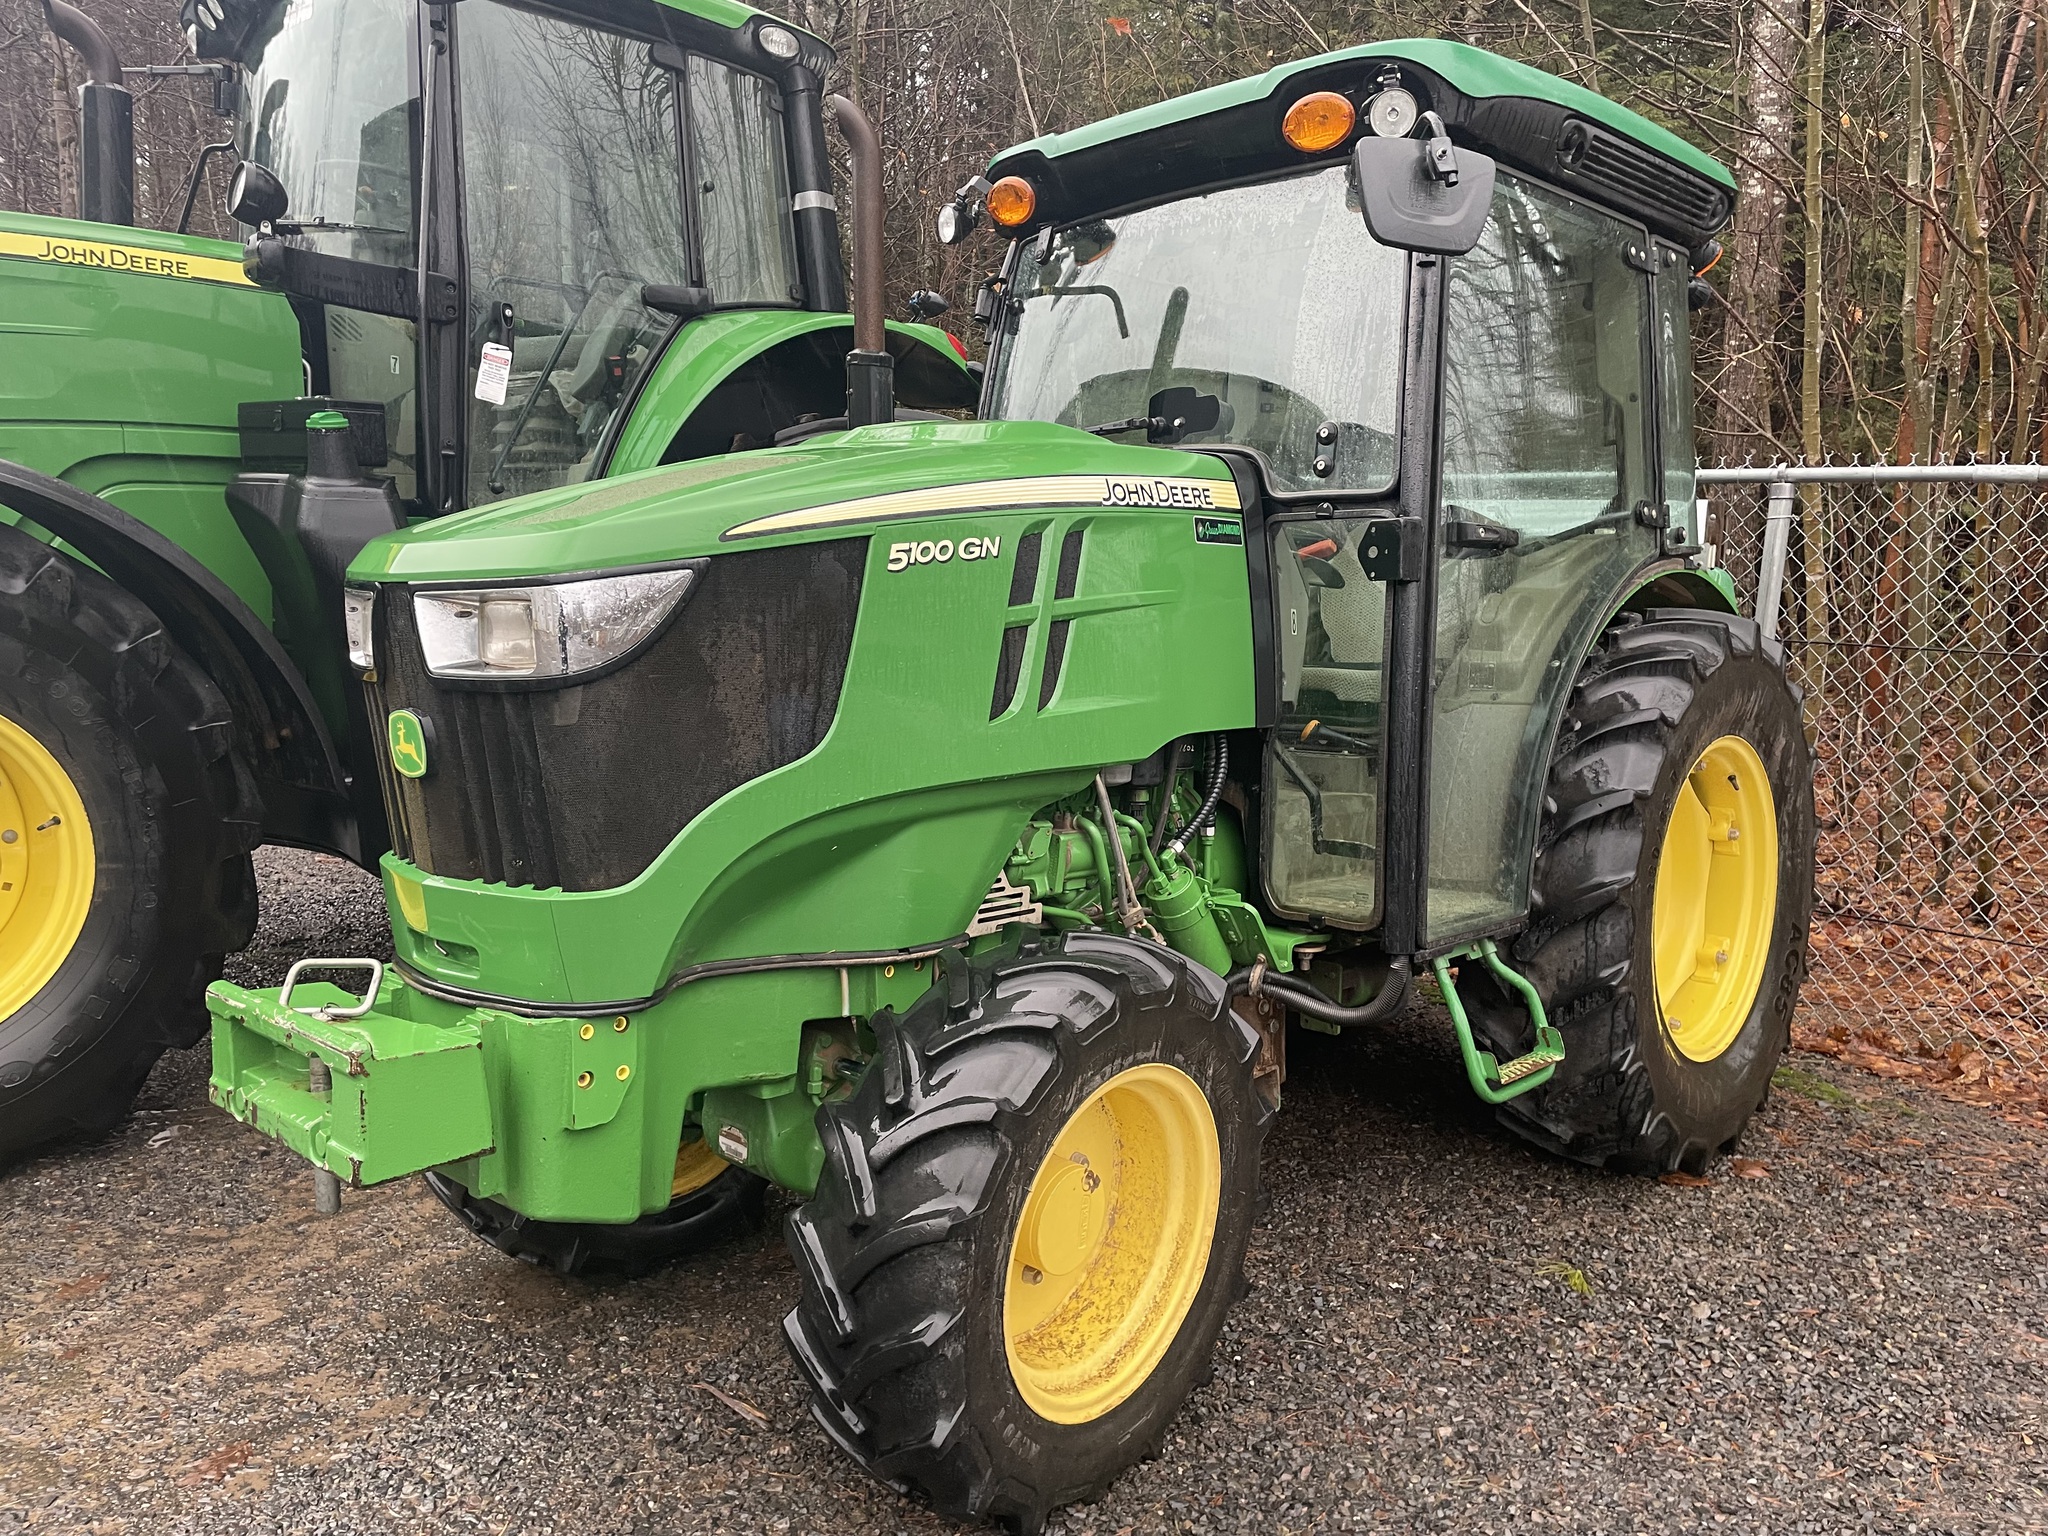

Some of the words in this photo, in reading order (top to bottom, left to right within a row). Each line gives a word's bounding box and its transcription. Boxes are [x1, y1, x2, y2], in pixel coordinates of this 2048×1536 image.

[38, 241, 104, 266] JOHN
[110, 249, 189, 276] DEERE
[1102, 478, 1154, 502] JOHN
[1154, 480, 1214, 506] DEERE
[887, 539, 955, 573] 5100
[958, 535, 1001, 562] GN
